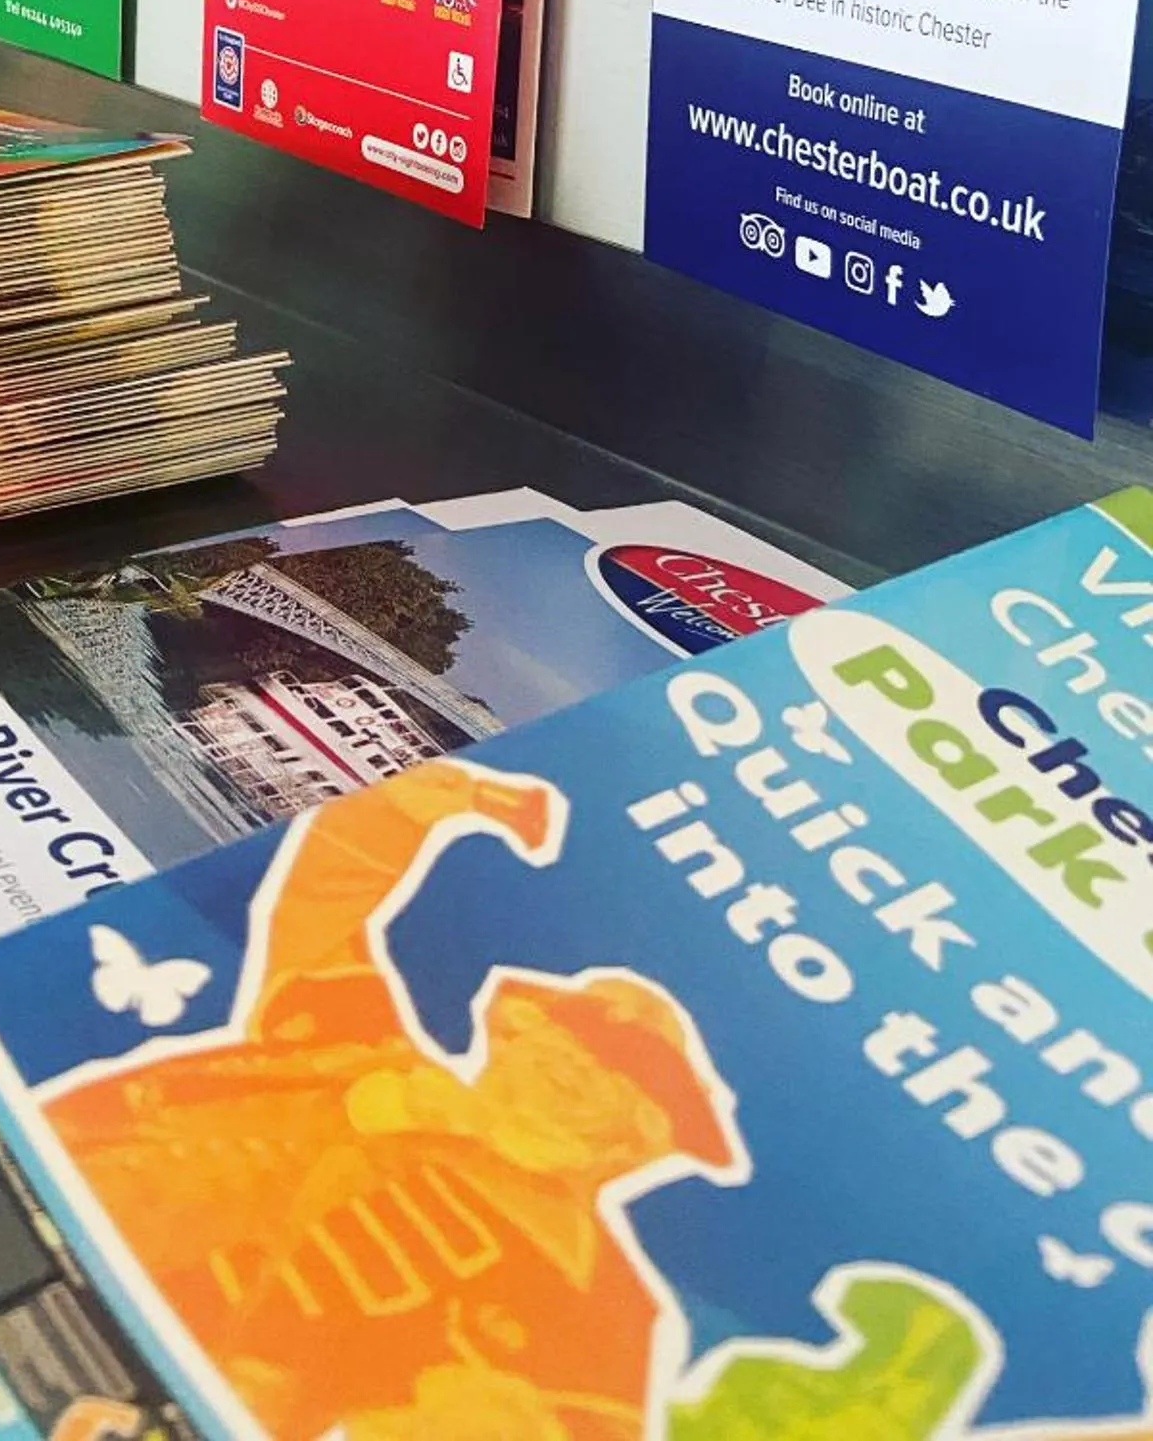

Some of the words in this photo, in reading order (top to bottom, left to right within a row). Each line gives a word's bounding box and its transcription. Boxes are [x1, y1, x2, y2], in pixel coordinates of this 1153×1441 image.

[788, 73, 836, 110] Book
[839, 92, 900, 128] online
[904, 108, 927, 135] at
[918, 11, 991, 50] Chester
[688, 103, 1047, 242] www.chesterboat.co.uk
[775, 186, 801, 211] Find
[805, 198, 820, 216] us
[821, 204, 837, 222] on
[840, 208, 877, 237] social
[879, 219, 922, 250] media
[990, 587, 1153, 763] Che
[666, 671, 977, 973] Quick
[831, 644, 1128, 910] Park
[978, 688, 1153, 865] Che
[626, 781, 855, 1003] into
[862, 1011, 1084, 1197] the
